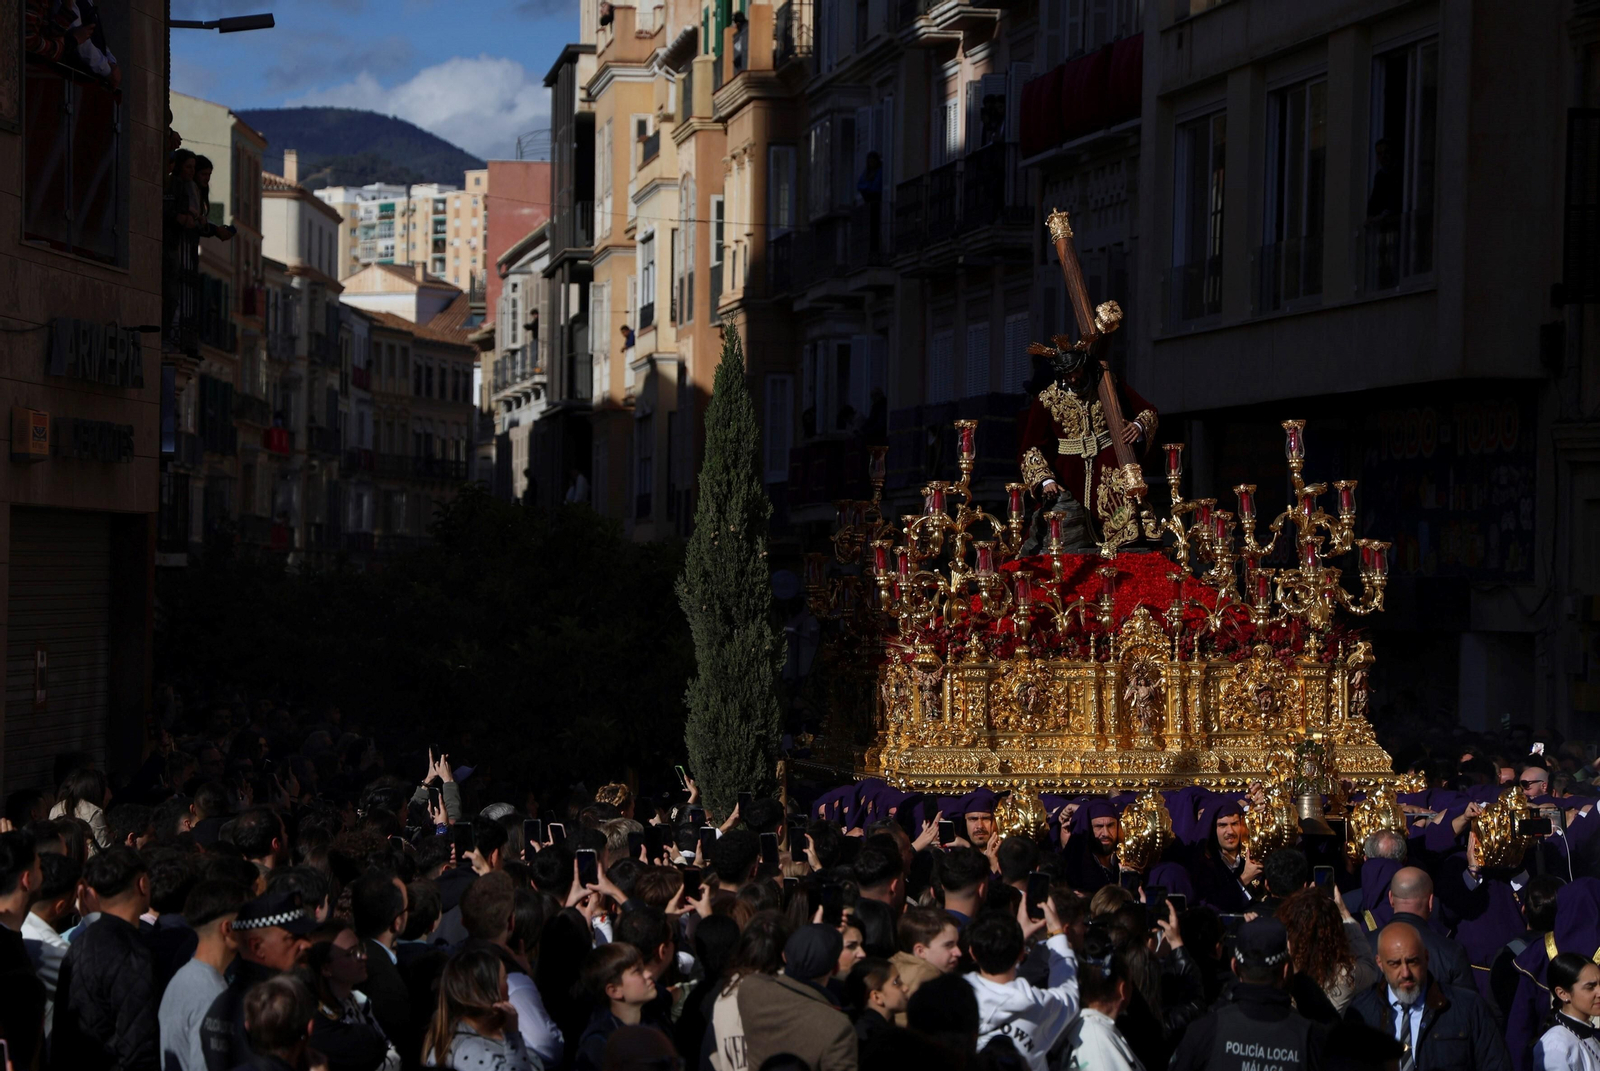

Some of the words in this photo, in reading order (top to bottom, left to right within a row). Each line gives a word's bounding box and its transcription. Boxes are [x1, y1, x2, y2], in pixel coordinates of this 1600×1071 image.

[1378, 407, 1438, 461] TODO
[1453, 398, 1520, 456] TODO
[1001, 1022, 1034, 1052] OWN
[1225, 1040, 1265, 1059] POLICÍA
[1267, 1047, 1300, 1063] LOCAL
